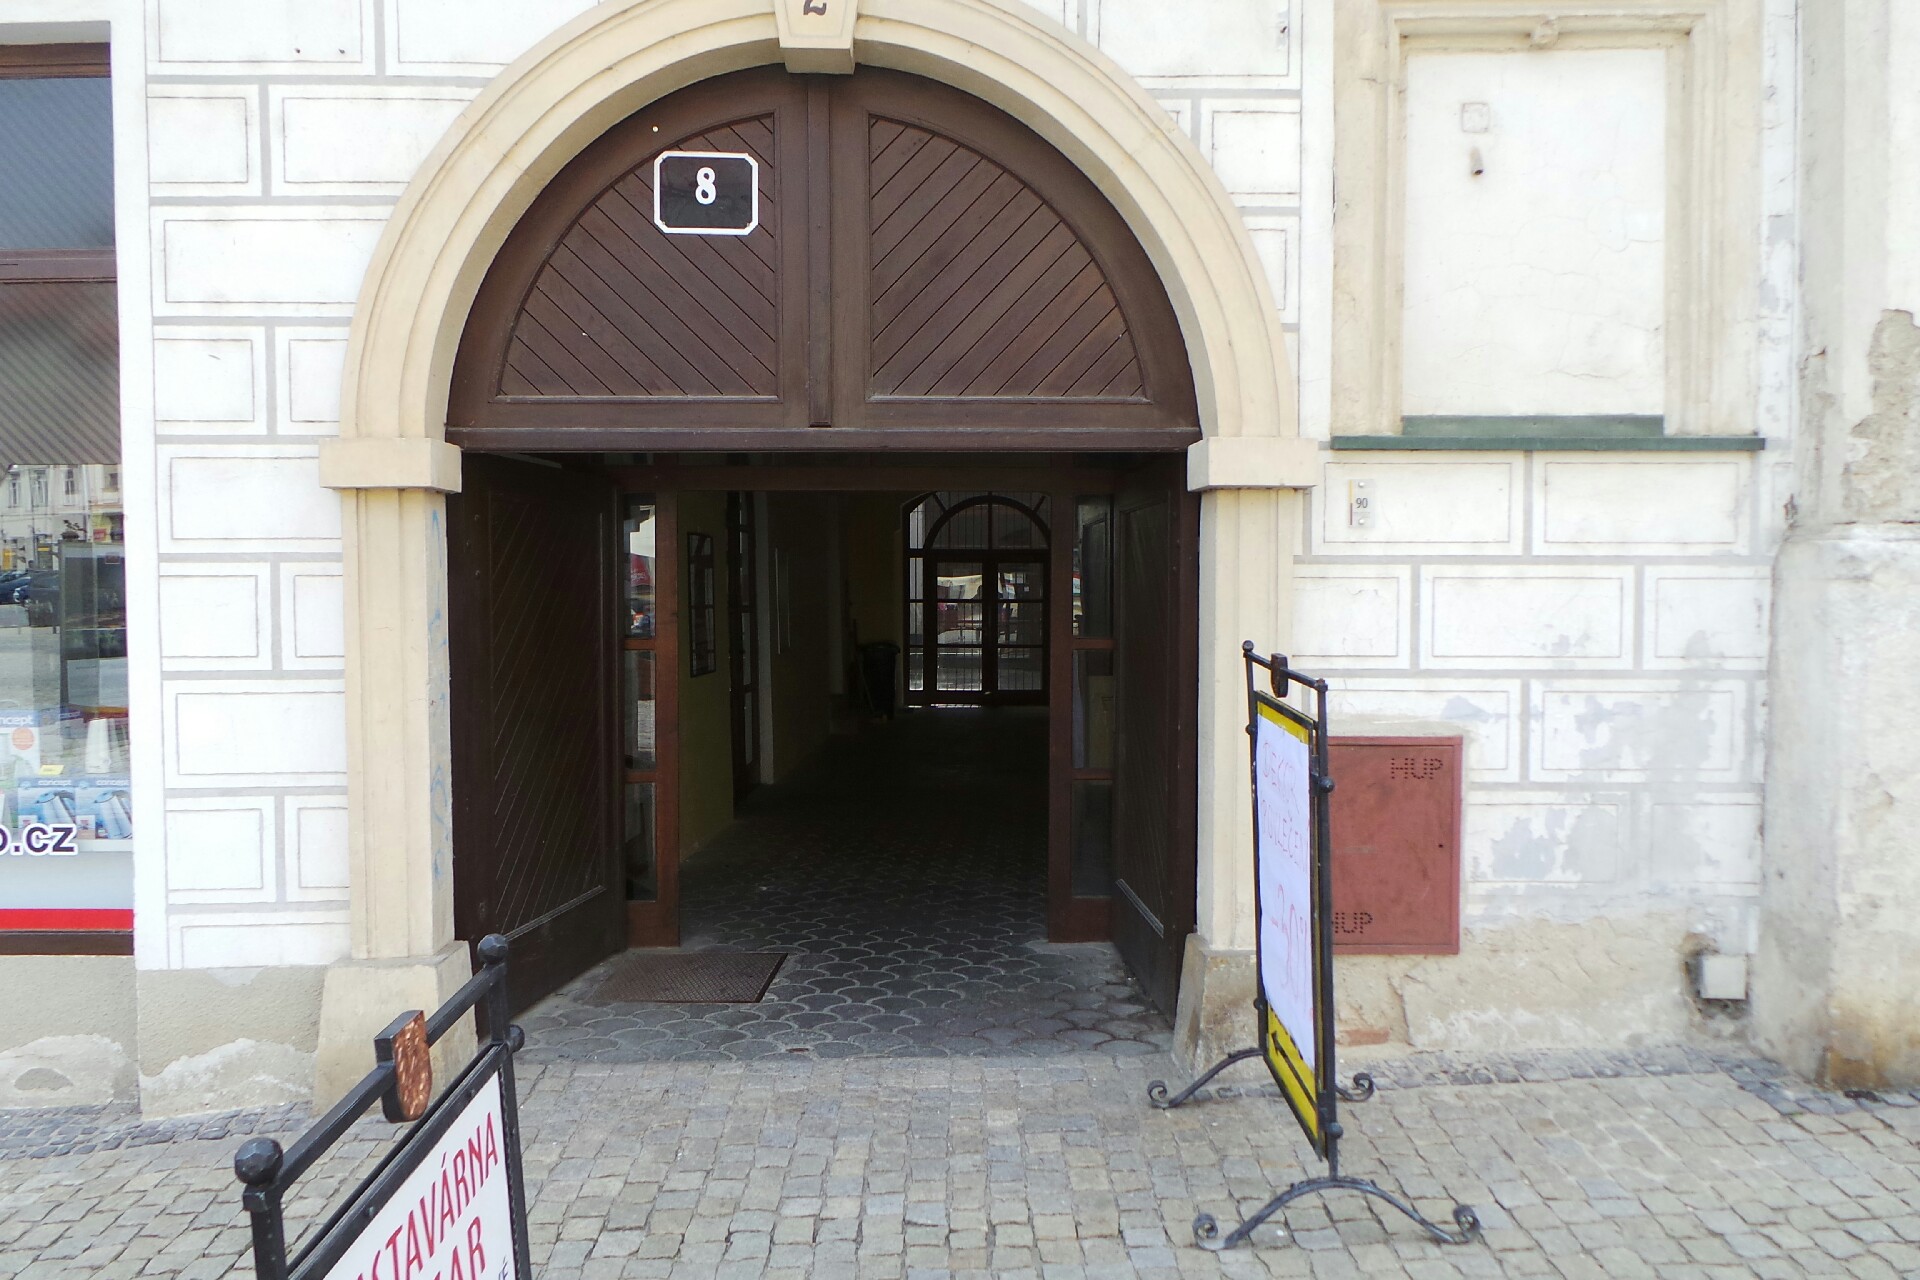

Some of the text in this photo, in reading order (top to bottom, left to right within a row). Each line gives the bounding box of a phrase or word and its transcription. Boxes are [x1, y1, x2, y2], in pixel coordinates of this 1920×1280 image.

[695, 167, 717, 205] 8
[1355, 497, 1368, 509] 90
[1391, 757, 1444, 780] HUP
